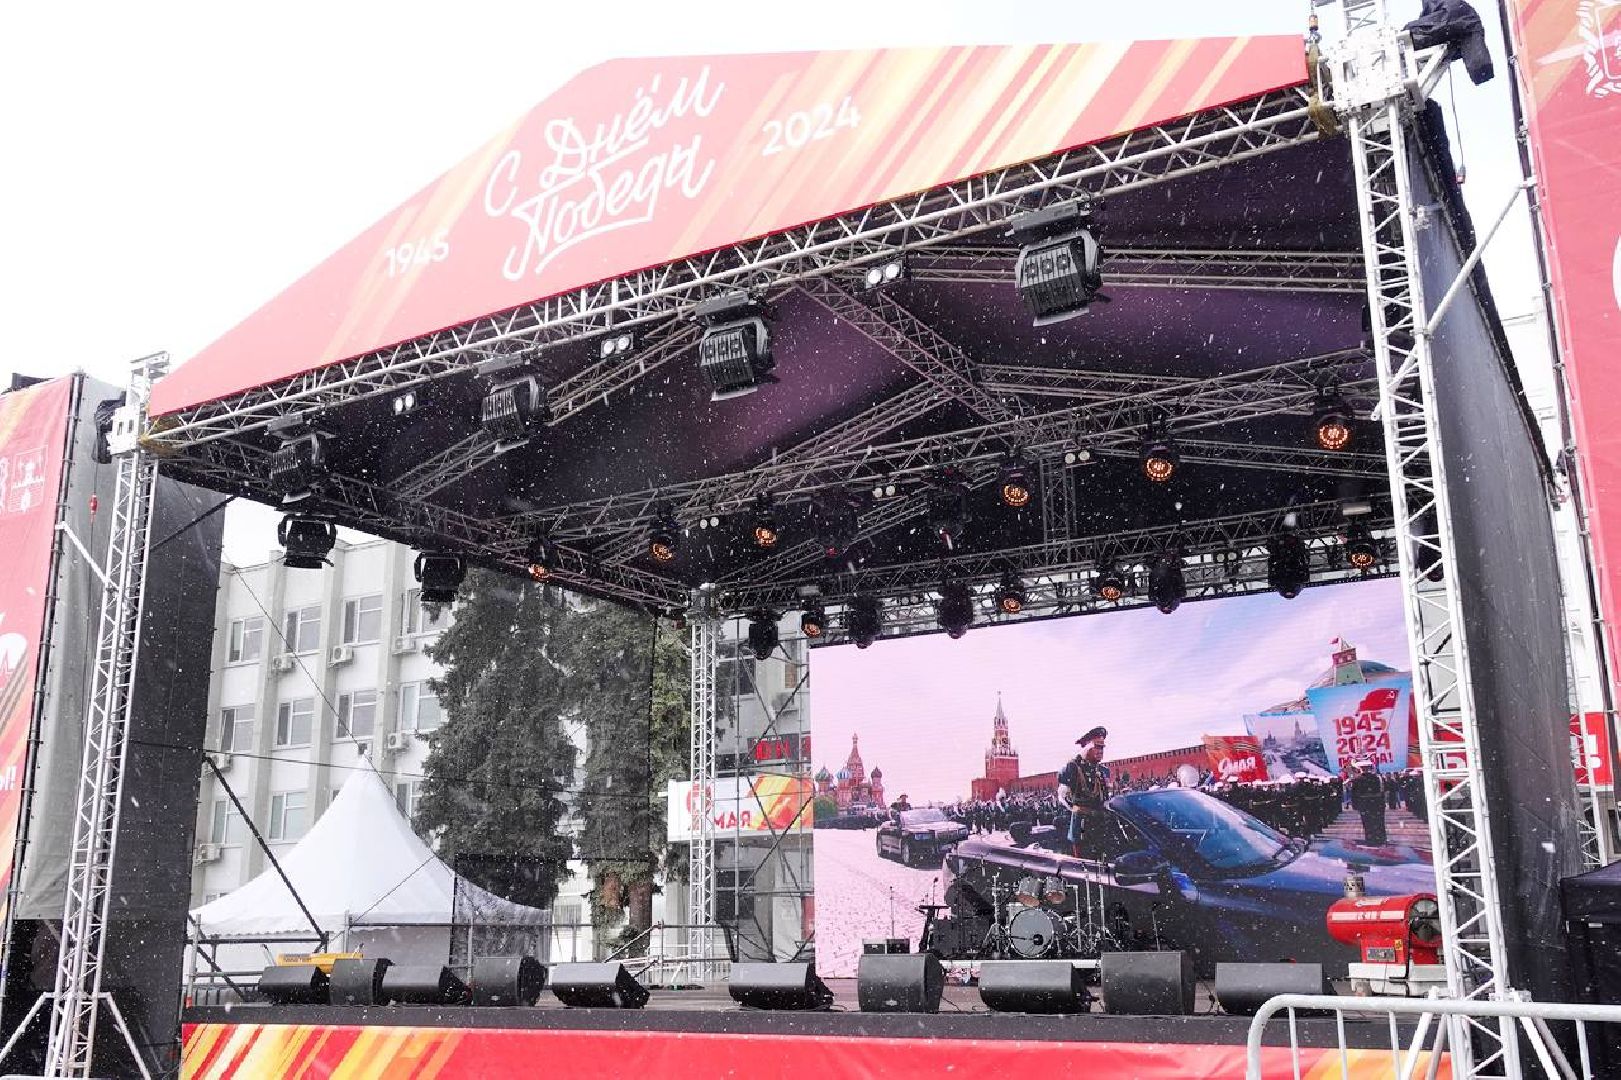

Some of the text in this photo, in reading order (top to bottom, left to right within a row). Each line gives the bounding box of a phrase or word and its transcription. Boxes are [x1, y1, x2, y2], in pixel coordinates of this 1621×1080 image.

[483, 64, 726, 218] С Днём
[762, 95, 862, 157] 2024
[503, 134, 716, 281] Победы
[384, 228, 450, 279] 1945
[1332, 711, 1388, 736] 1945
[1335, 733, 1392, 755] 2024
